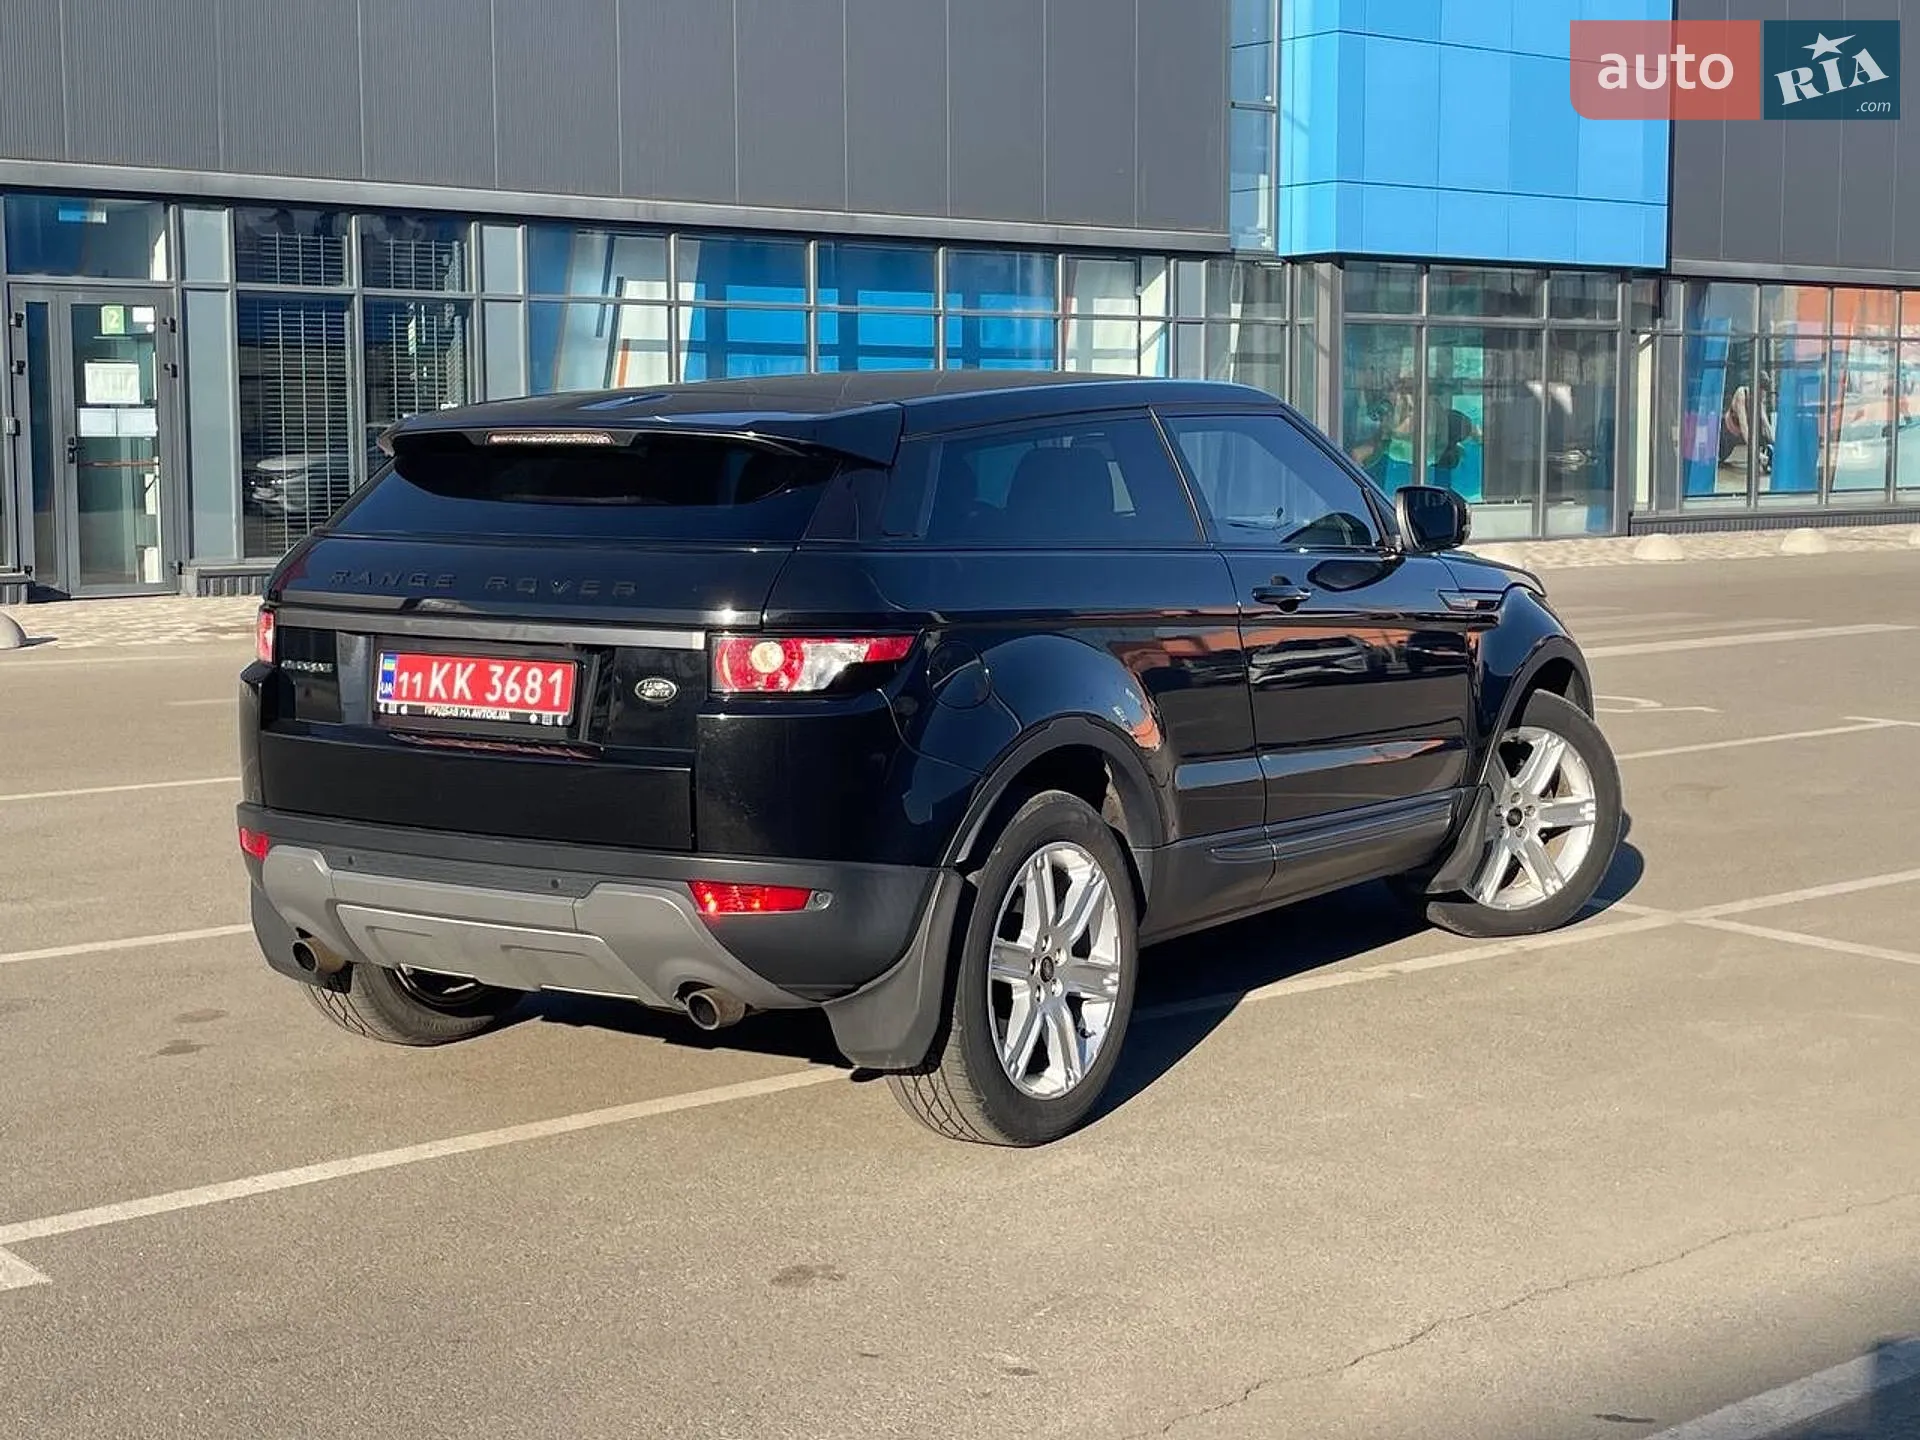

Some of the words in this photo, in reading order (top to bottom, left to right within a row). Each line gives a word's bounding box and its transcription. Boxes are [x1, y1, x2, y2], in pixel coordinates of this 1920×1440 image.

[330, 569, 456, 588] RANGE
[485, 576, 638, 597] ROVER
[398, 671, 423, 698] 11
[428, 661, 477, 701] KK
[484, 664, 564, 707] 3681
